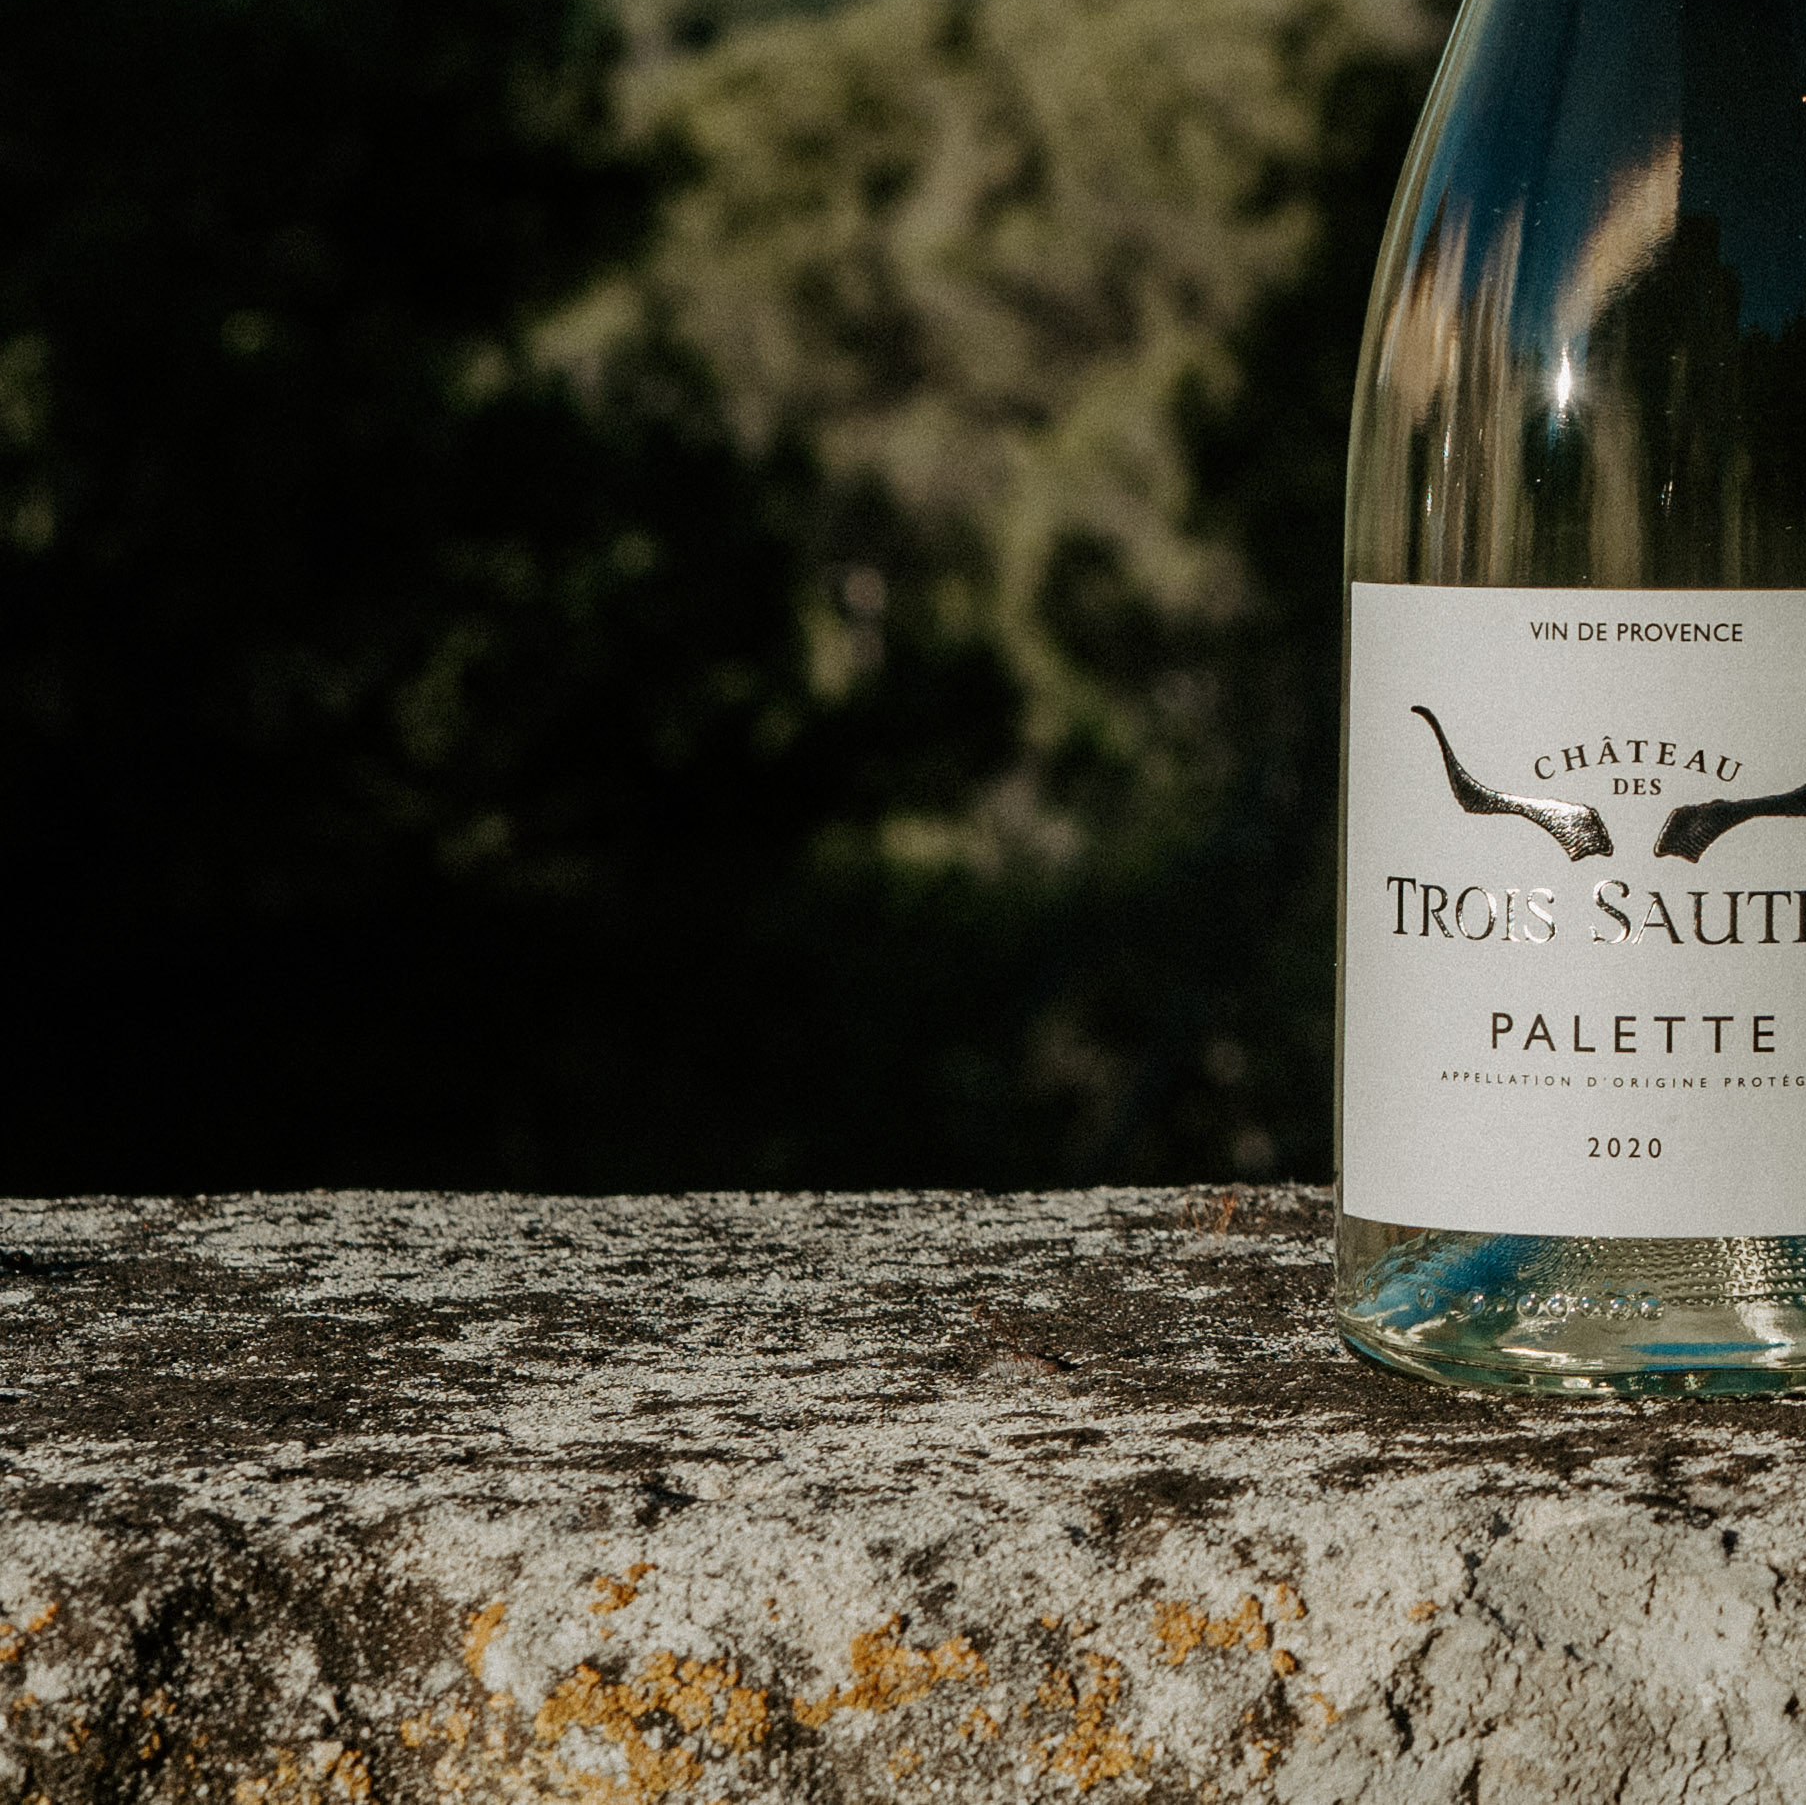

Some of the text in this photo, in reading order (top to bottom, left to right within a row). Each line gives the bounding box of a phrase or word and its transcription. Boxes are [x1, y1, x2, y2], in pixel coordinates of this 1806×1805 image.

[1529, 621, 1744, 643] VIN DE PROVENCE
[1533, 735, 1743, 784] CHÂTEAU
[1612, 777, 1662, 796] DES
[1386, 875, 1557, 945] TROIS
[1490, 1011, 1777, 1055] PALETTE
[1440, 1070, 1571, 1087] APPELLATION
[1587, 1075, 1708, 1090] D'ORIGINE
[1586, 1136, 1664, 1159] 2020
